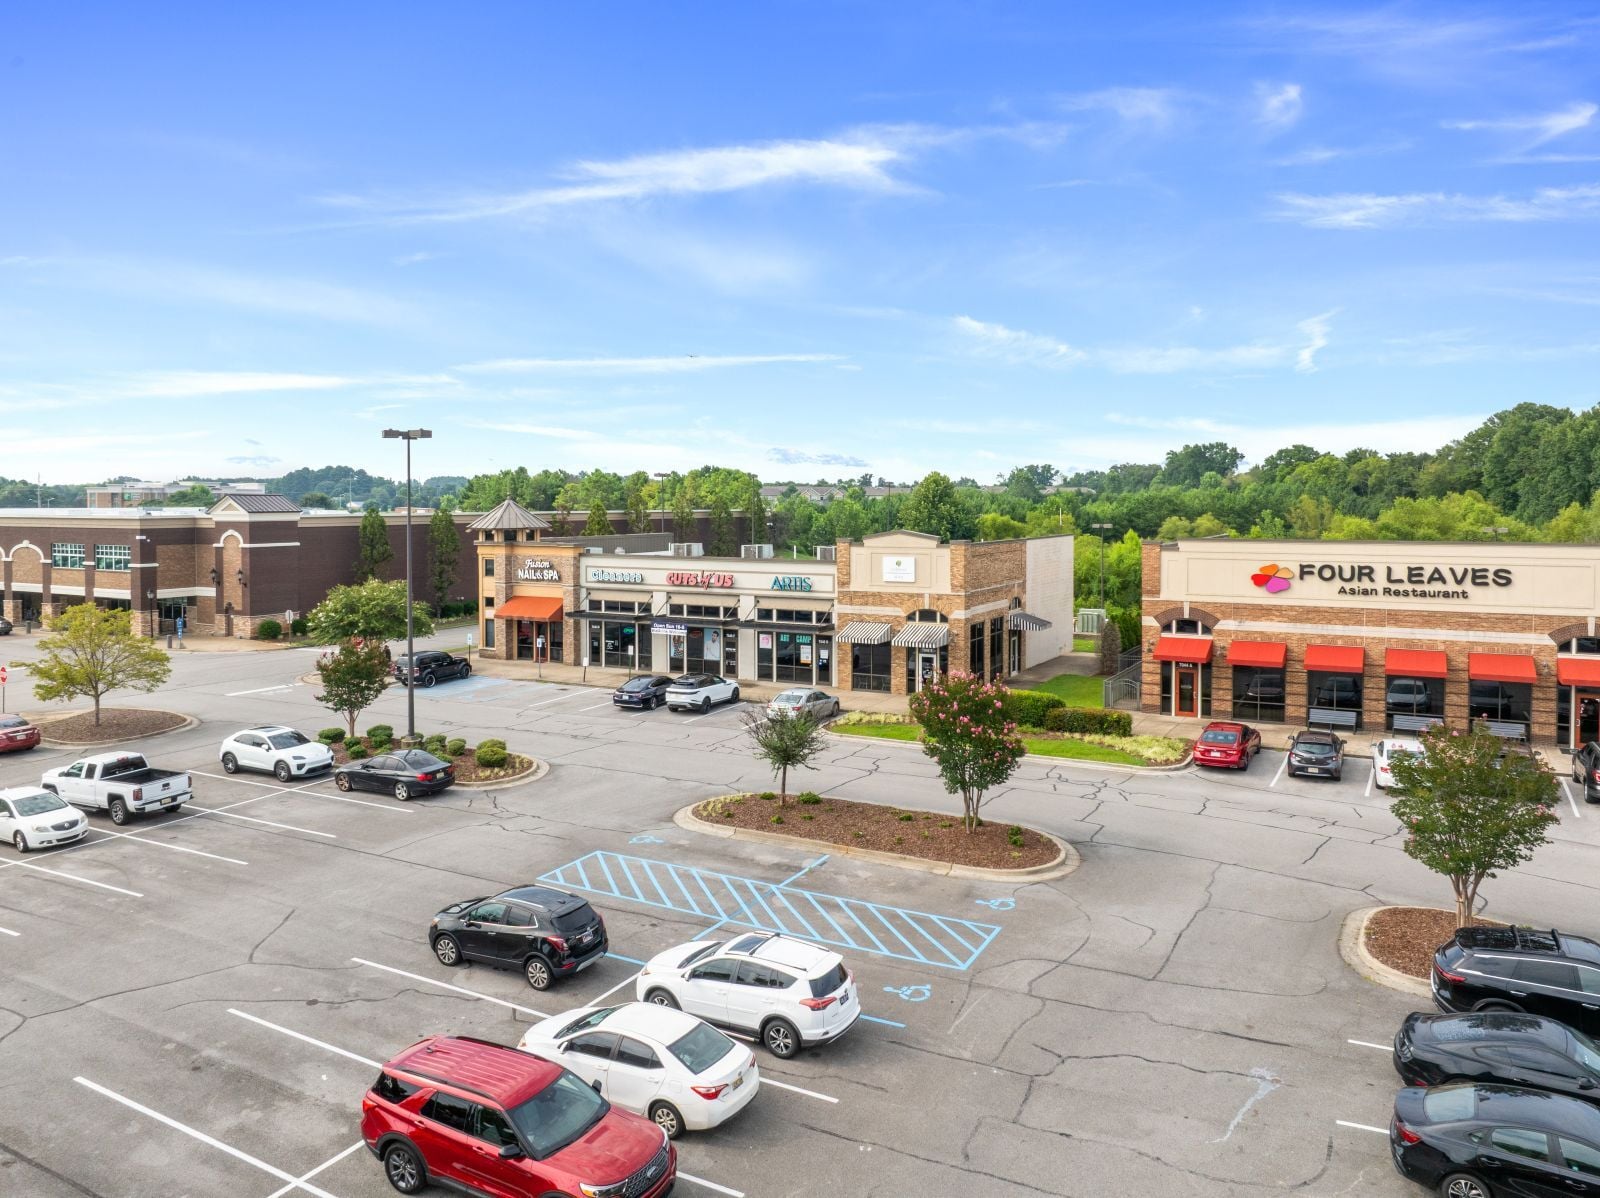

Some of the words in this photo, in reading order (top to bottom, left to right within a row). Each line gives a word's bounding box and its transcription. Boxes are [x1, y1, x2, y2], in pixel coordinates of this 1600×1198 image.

[525, 559, 551, 569] Fusion
[665, 572, 699, 586] CUTS
[713, 574, 735, 588] US
[1299, 563, 1376, 583] FOUR
[1386, 565, 1513, 587] LEAVES
[770, 575, 812, 592] ARTIS
[1337, 585, 1378, 597] Asian
[1382, 586, 1469, 600] Restaurant
[796, 635, 812, 644] CAMP
